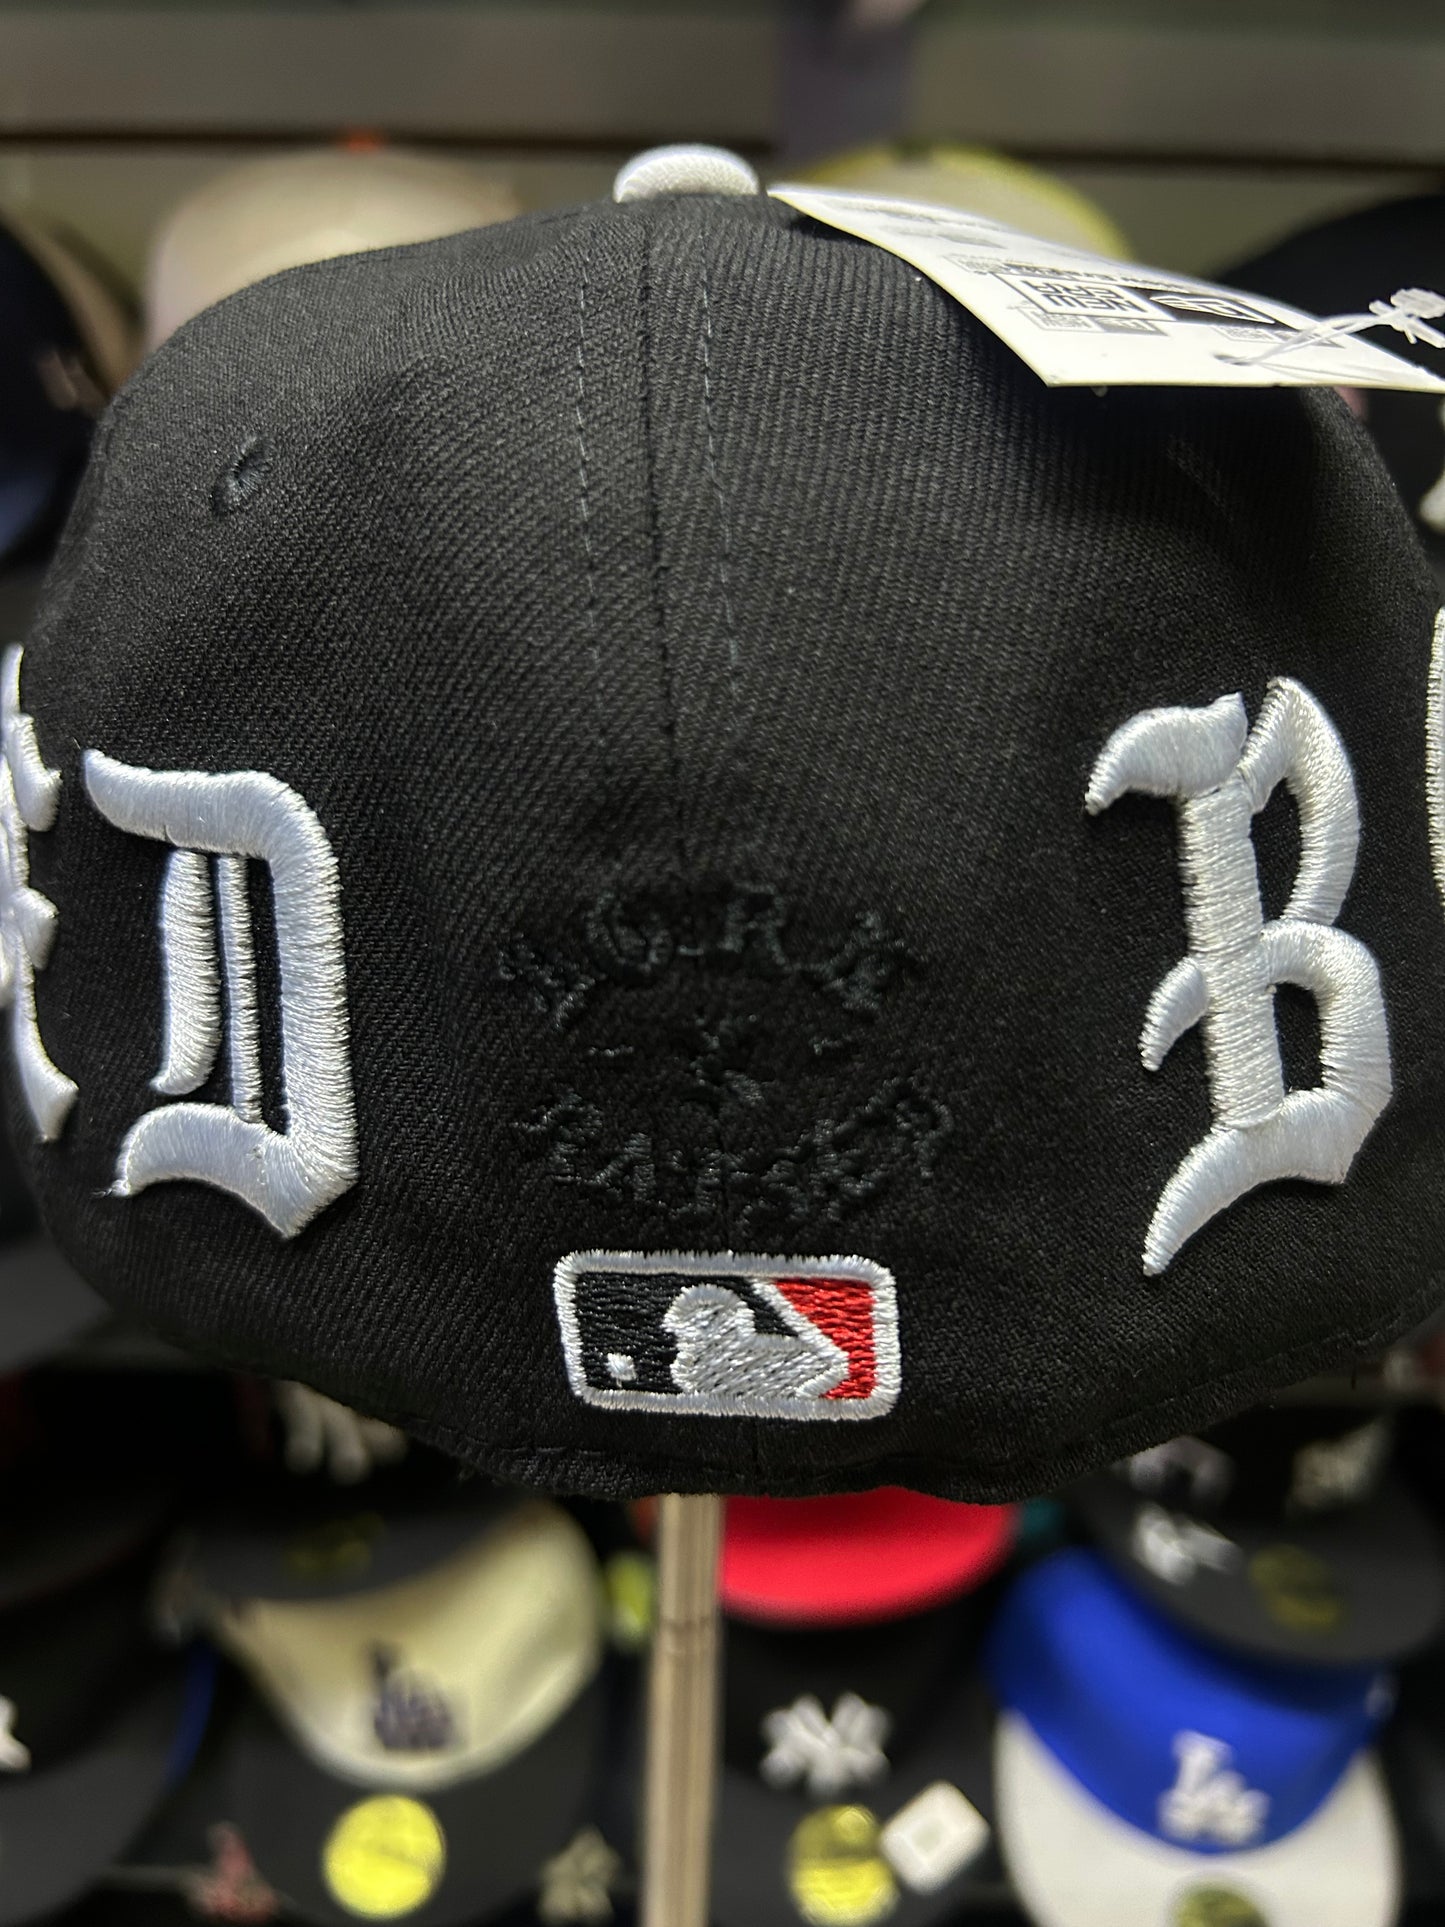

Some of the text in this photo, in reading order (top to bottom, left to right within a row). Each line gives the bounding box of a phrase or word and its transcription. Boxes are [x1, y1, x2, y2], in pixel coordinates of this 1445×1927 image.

[1020, 280, 1124, 300] ERA
[1041, 293, 1148, 313] NEW
[83, 748, 359, 1239] D
[1084, 676, 1393, 1276] B
